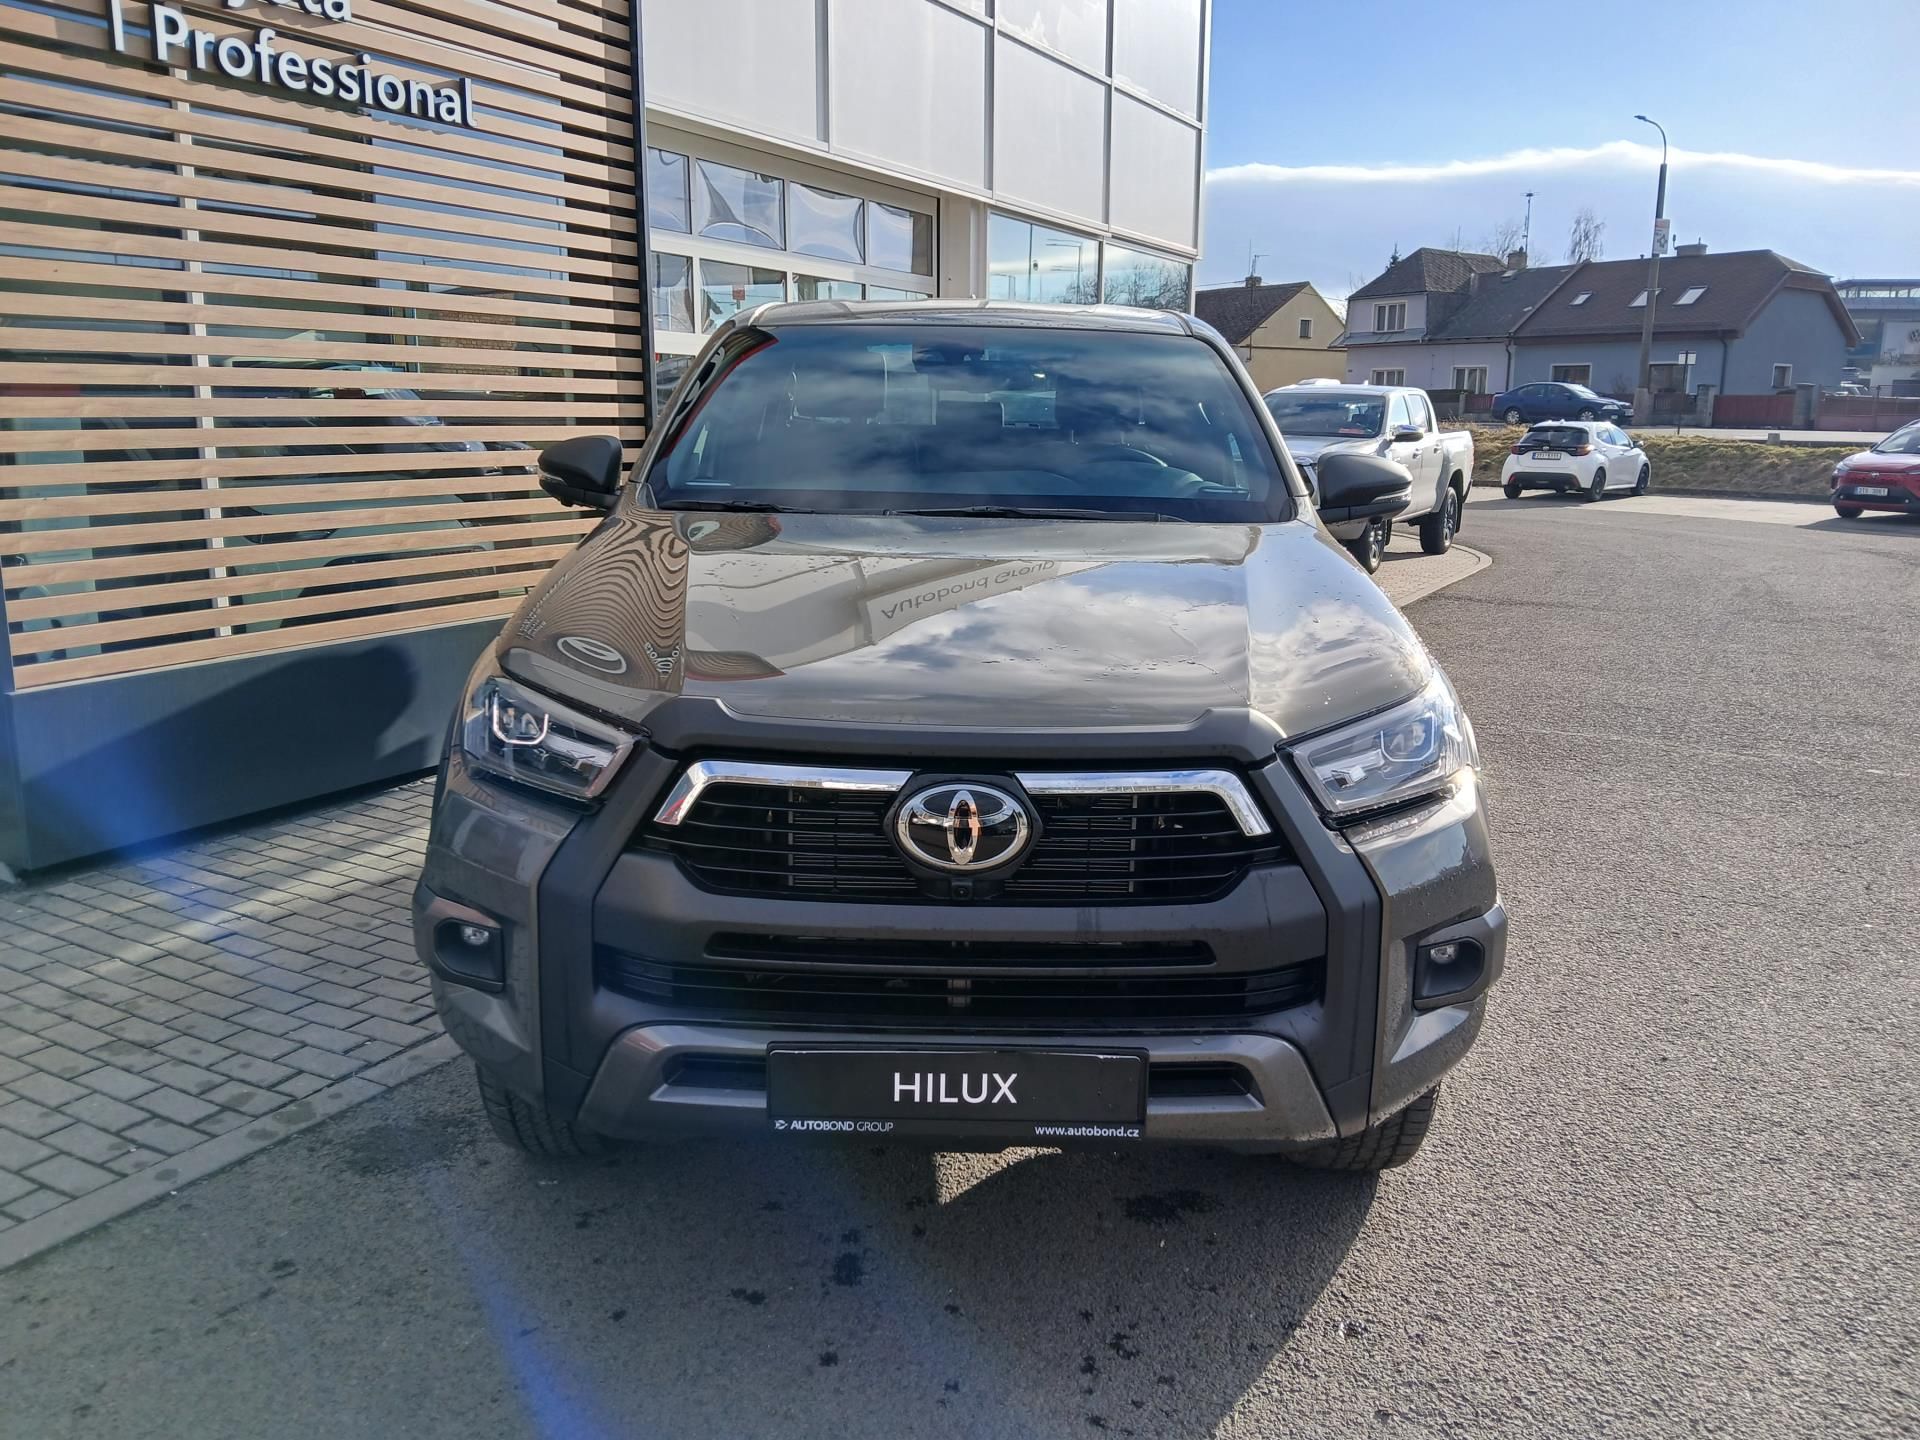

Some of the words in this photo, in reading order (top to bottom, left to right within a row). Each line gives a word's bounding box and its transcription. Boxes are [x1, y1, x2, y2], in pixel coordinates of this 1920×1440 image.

[152, 3, 478, 128] Professional
[892, 1071, 1018, 1105] HILUX
[790, 1119, 855, 1132] AUTOBOND
[856, 1121, 894, 1133] GROUP
[1034, 1125, 1140, 1138] www.autobond.cz
